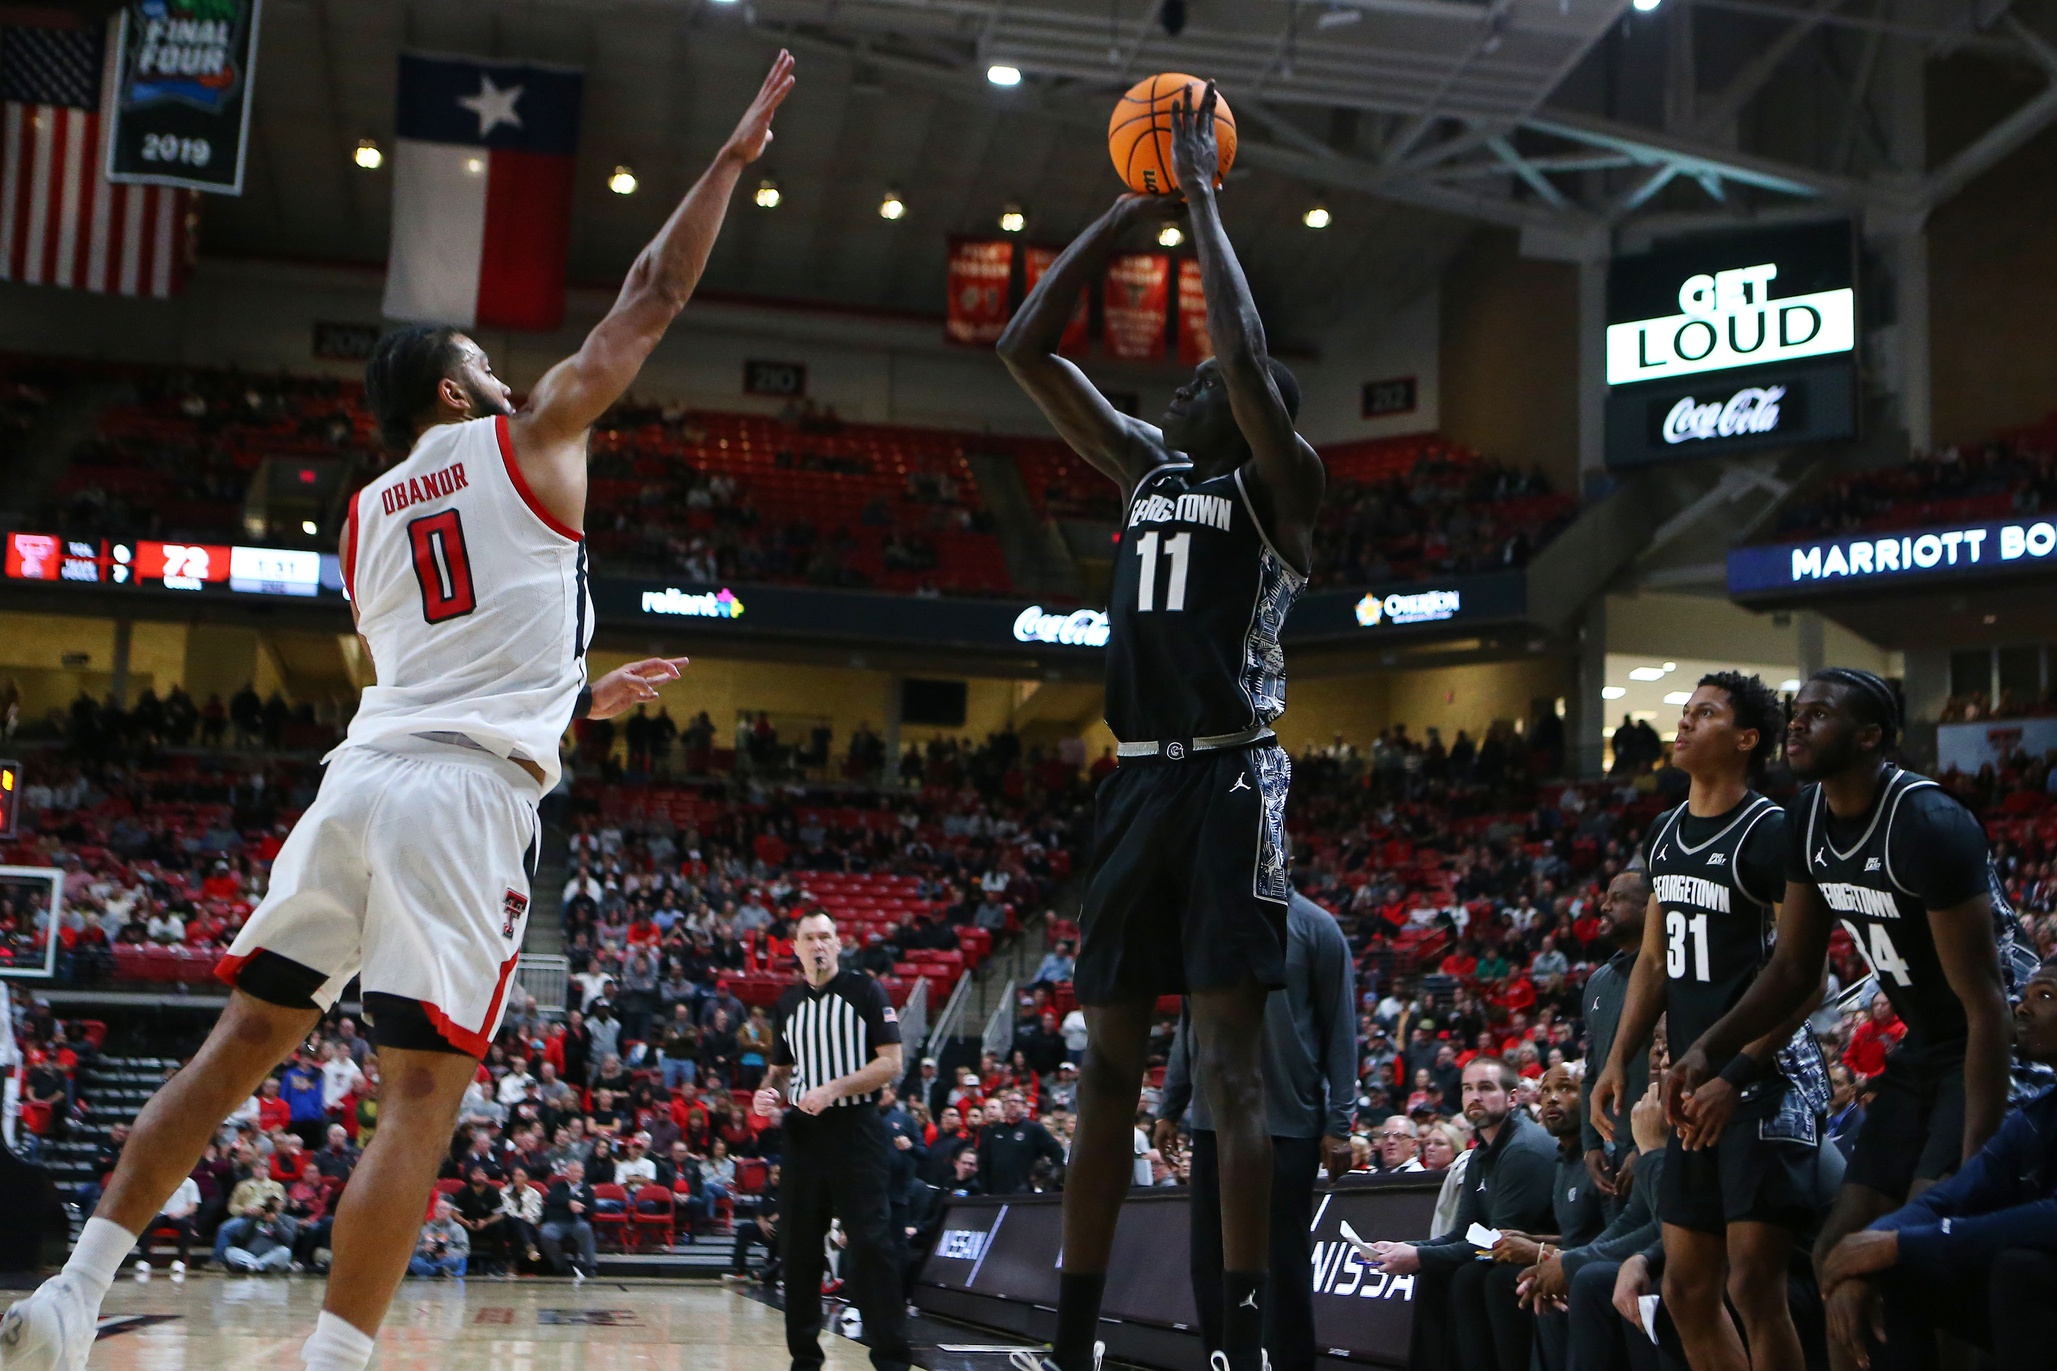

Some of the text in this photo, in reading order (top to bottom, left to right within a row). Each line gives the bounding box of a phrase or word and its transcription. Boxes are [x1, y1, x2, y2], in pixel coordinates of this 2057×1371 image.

[139, 43, 225, 76] FOUR
[147, 19, 229, 48] FINAL
[141, 132, 211, 167] 2019
[1679, 263, 1777, 317] GET
[1639, 305, 1822, 368] LOUD
[753, 365, 796, 391] 210
[381, 462, 469, 516] OBANOR
[163, 545, 209, 578] 72
[407, 508, 477, 625] 0
[1136, 531, 1192, 612] 11
[1791, 522, 2057, 581] MARRIOTT BO
[1666, 910, 1711, 982] 31
